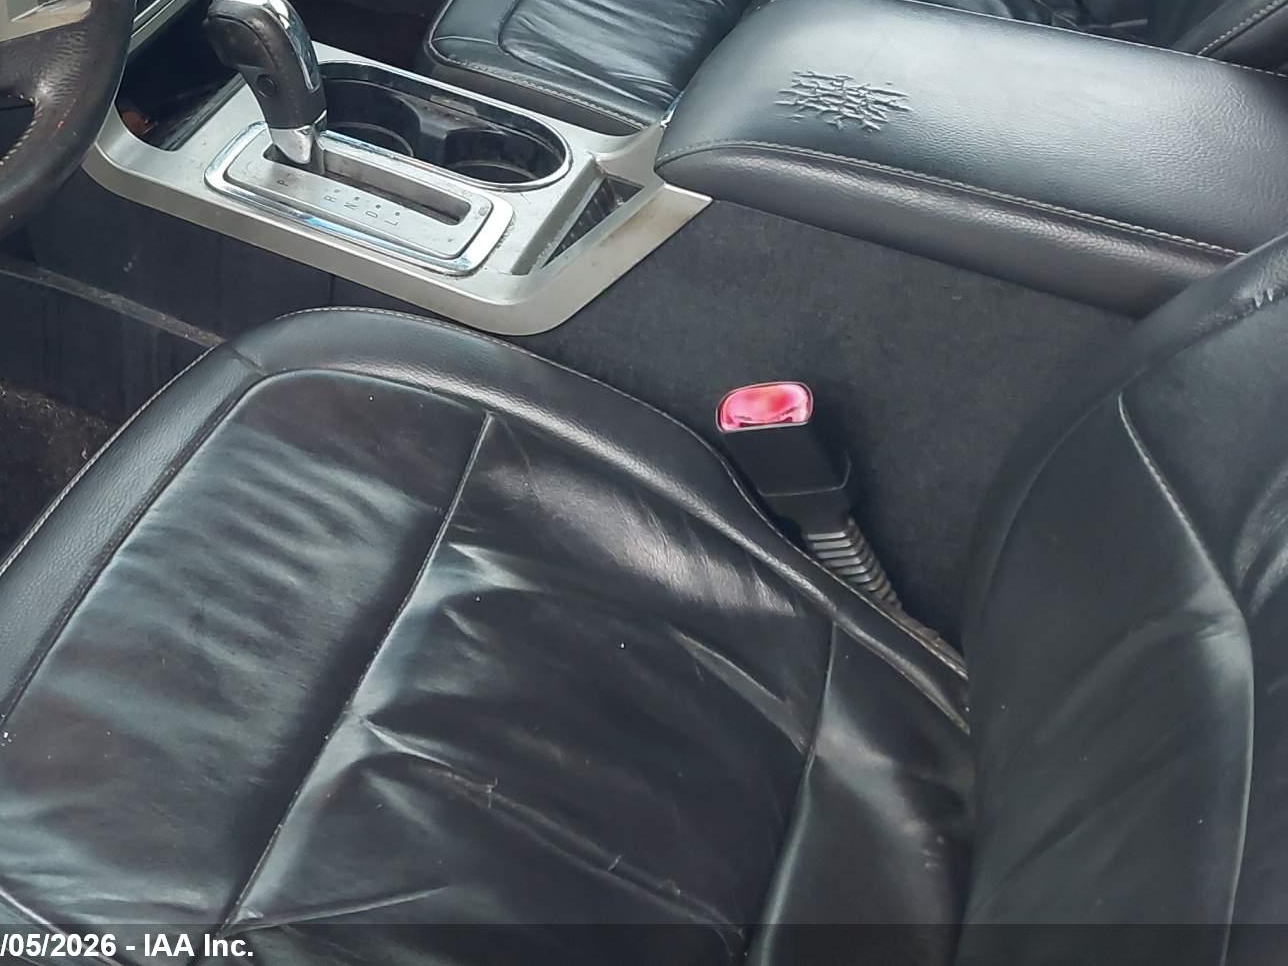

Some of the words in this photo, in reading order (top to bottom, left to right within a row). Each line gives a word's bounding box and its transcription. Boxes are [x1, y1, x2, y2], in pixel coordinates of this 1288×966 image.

[323, 195, 337, 203] R
[344, 202, 357, 210] N
[365, 210, 378, 219] D
